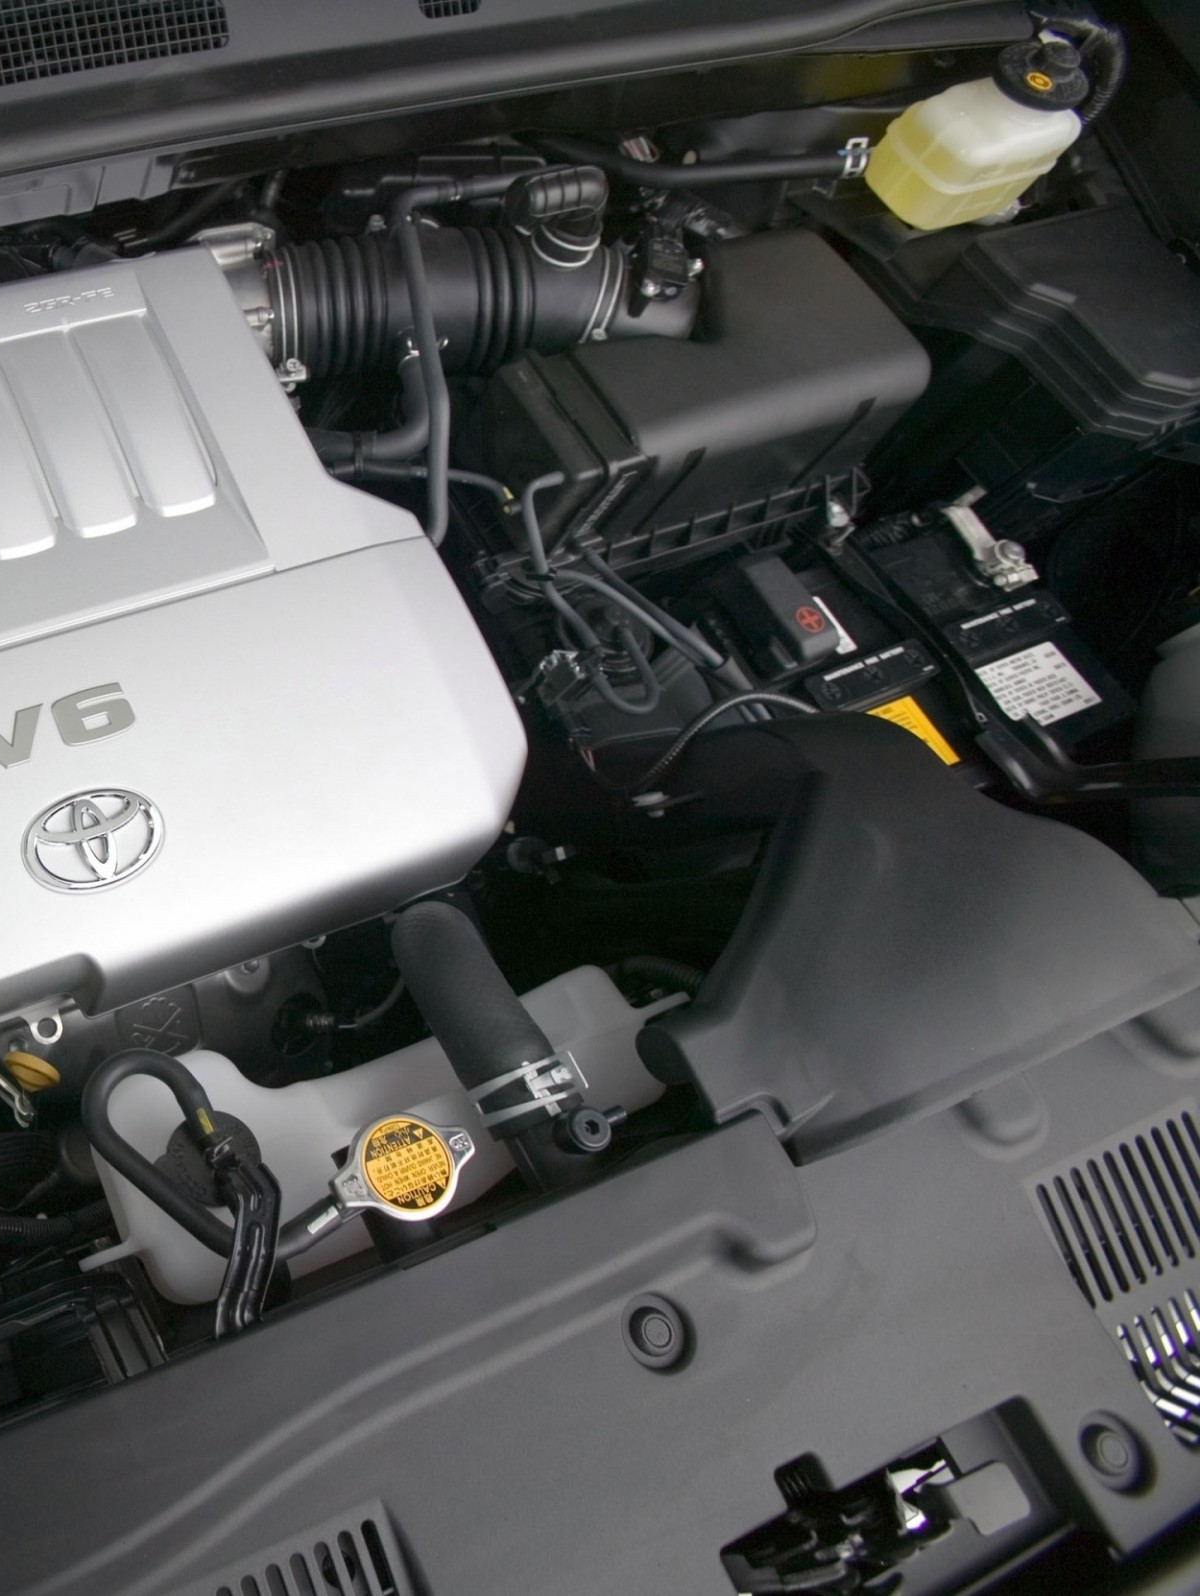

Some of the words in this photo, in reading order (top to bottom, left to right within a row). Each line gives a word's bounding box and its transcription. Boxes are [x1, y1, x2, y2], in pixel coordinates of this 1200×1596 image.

[370, 1136, 410, 1157] ATTENTION
[412, 1167, 426, 1177] OPEN
[429, 1161, 445, 1173] NEVER
[394, 1174, 409, 1184] WHEN
[397, 1183, 436, 1204] CAUTION
